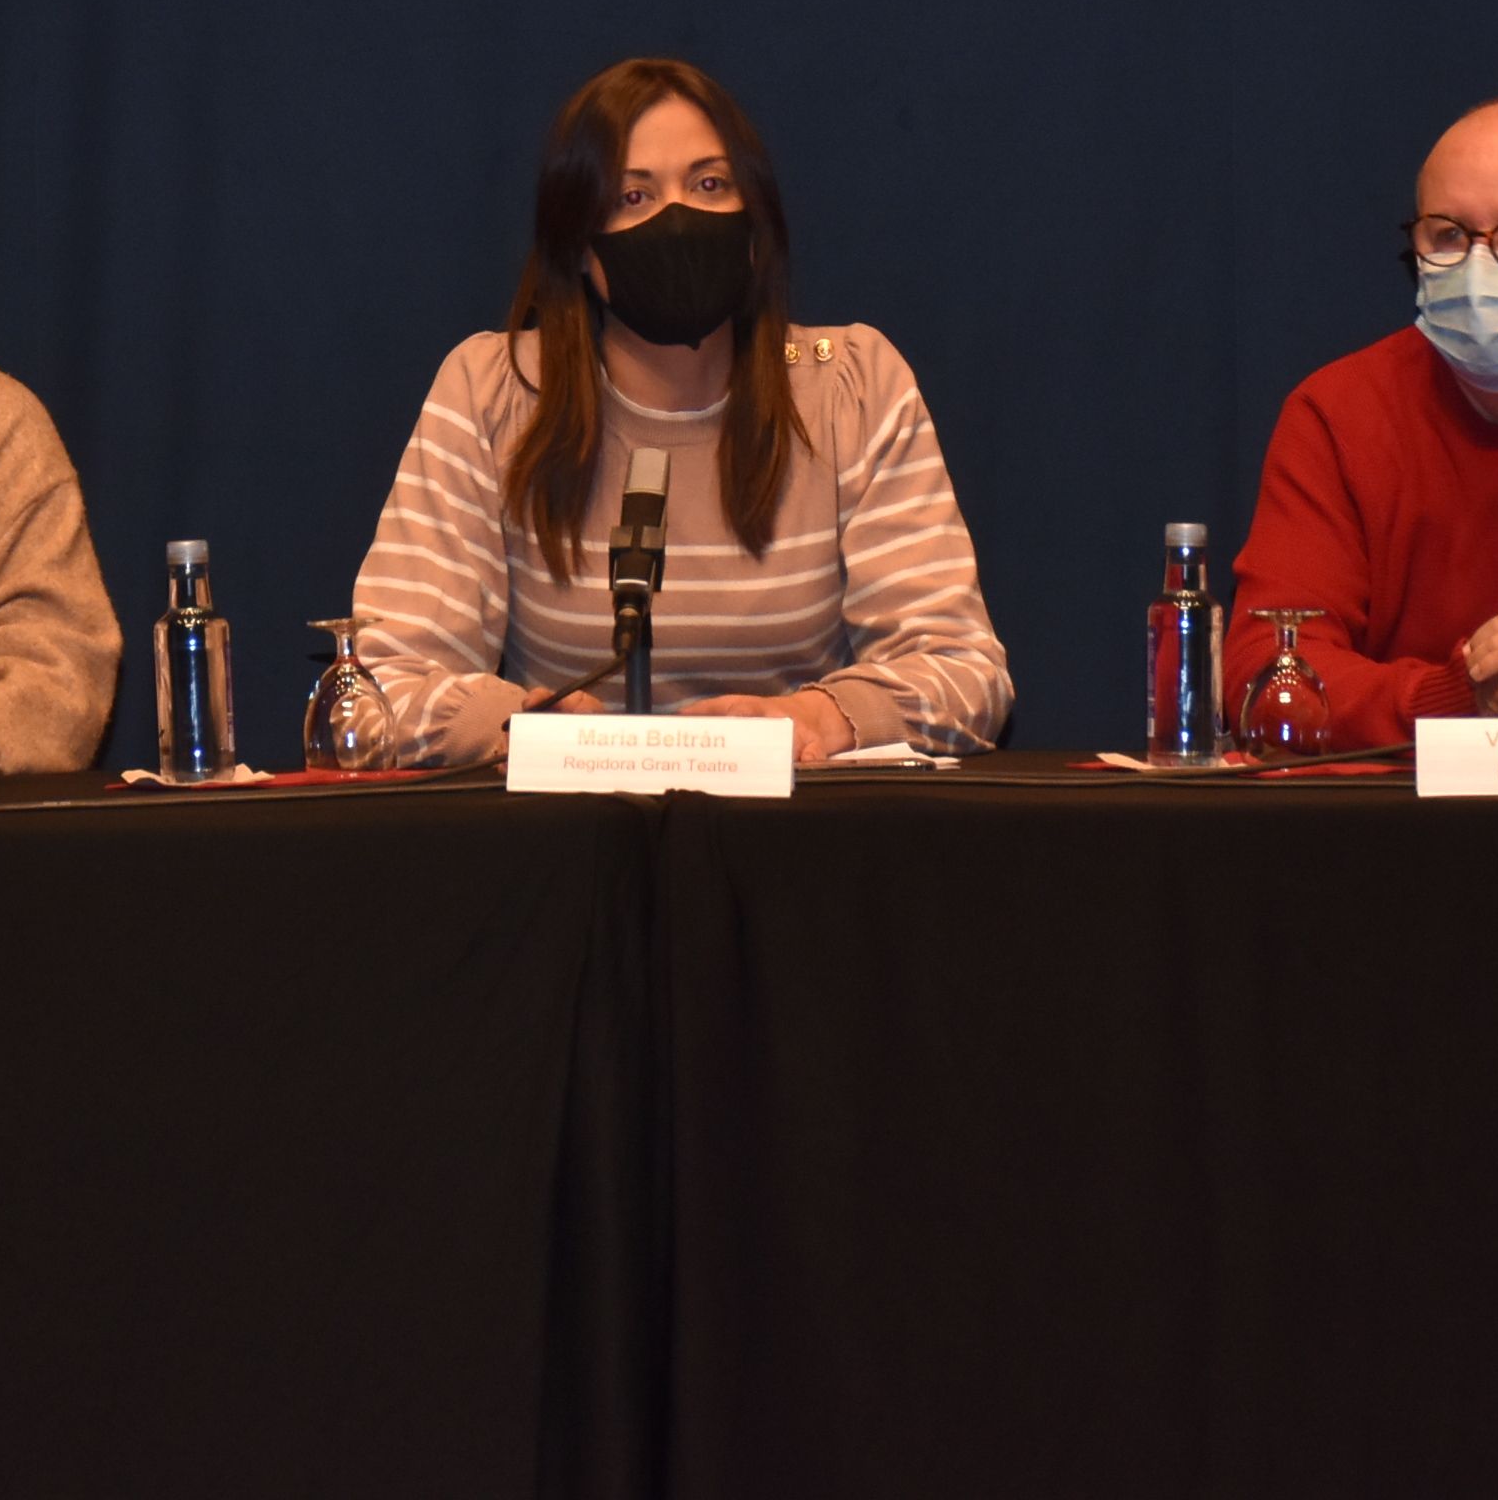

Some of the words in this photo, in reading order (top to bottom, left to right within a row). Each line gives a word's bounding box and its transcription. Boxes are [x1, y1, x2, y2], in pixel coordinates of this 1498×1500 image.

[563, 756, 636, 773] Regidora
[641, 757, 681, 771] Gran
[687, 758, 738, 773] Teatre
